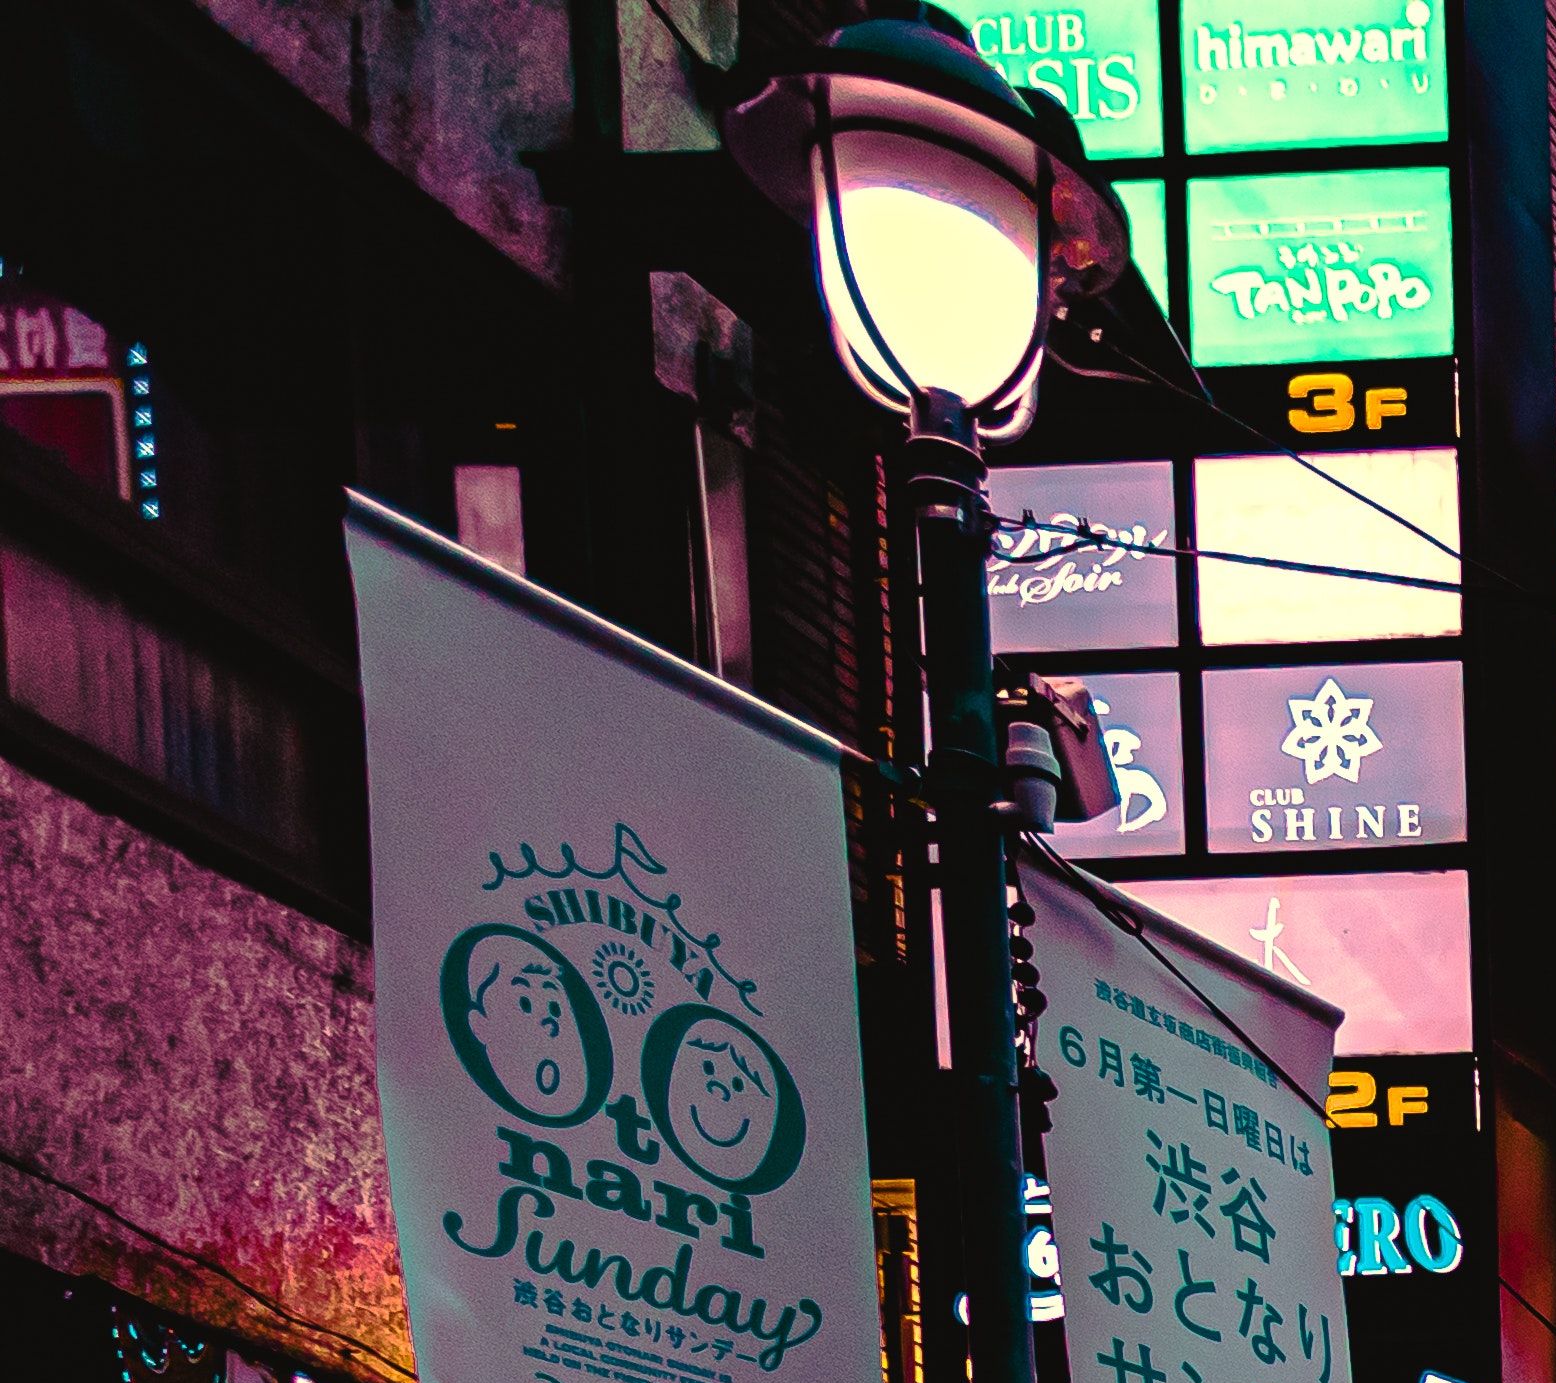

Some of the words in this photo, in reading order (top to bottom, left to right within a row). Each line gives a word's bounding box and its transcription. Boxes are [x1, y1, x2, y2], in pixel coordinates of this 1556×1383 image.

[972, 15, 1084, 55] CLUB
[1195, 3, 1429, 73] himawari
[1211, 269, 1431, 325] TANPOPO
[1287, 373, 1407, 432] 3F
[1249, 789, 1304, 806] CLUB
[1250, 805, 1422, 842] SHINE
[524, 887, 715, 1002] SHIBUYA
[1059, 1025, 1314, 1178] 6月第一日曜日は
[1327, 1071, 1430, 1128] 2F
[497, 1127, 765, 1259] nari
[1144, 1128, 1277, 1266] 渋谷
[442, 1185, 822, 1372] Sunday
[512, 1276, 757, 1365] 渋谷おとなりサンデー
